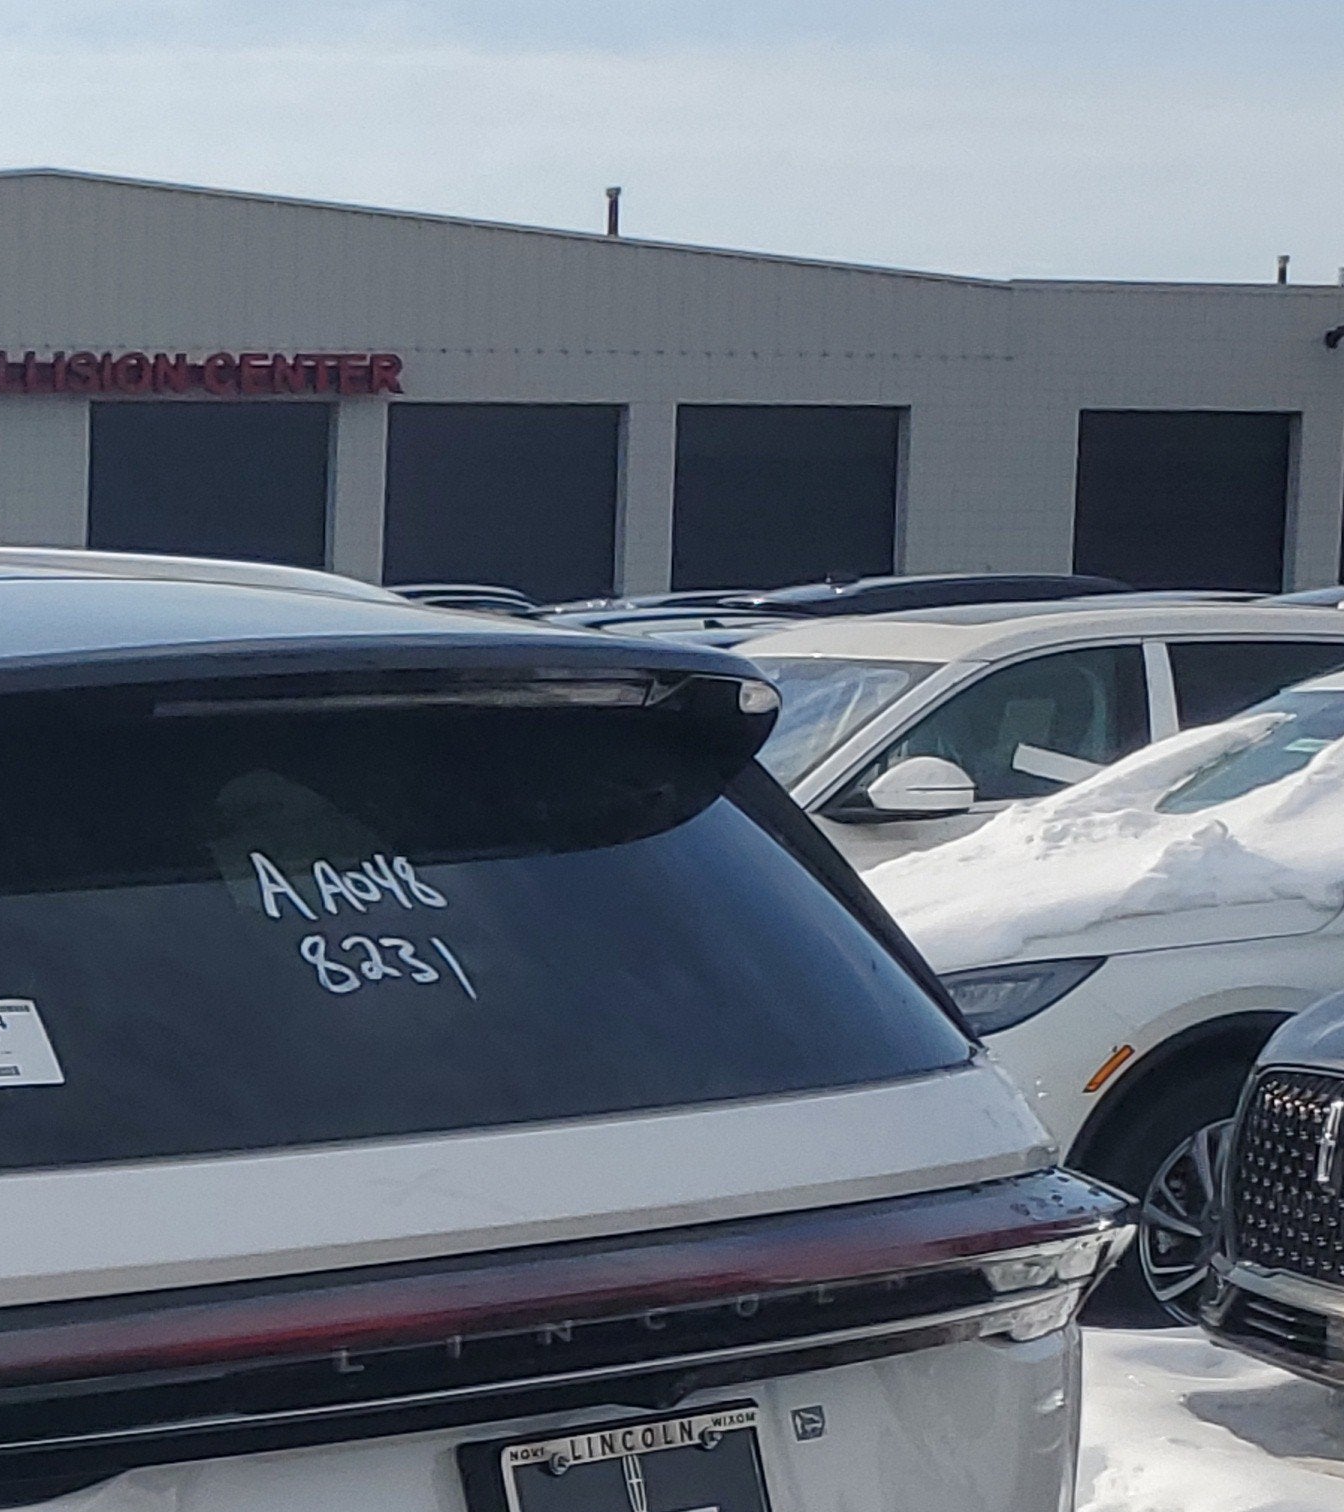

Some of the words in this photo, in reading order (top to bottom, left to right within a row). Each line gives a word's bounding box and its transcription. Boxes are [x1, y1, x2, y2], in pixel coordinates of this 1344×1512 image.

[203, 352, 404, 395] CENTER
[300, 934, 478, 1001] 8231
[570, 1420, 695, 1461] LINCOLN
[711, 1411, 756, 1428] WIXOM
